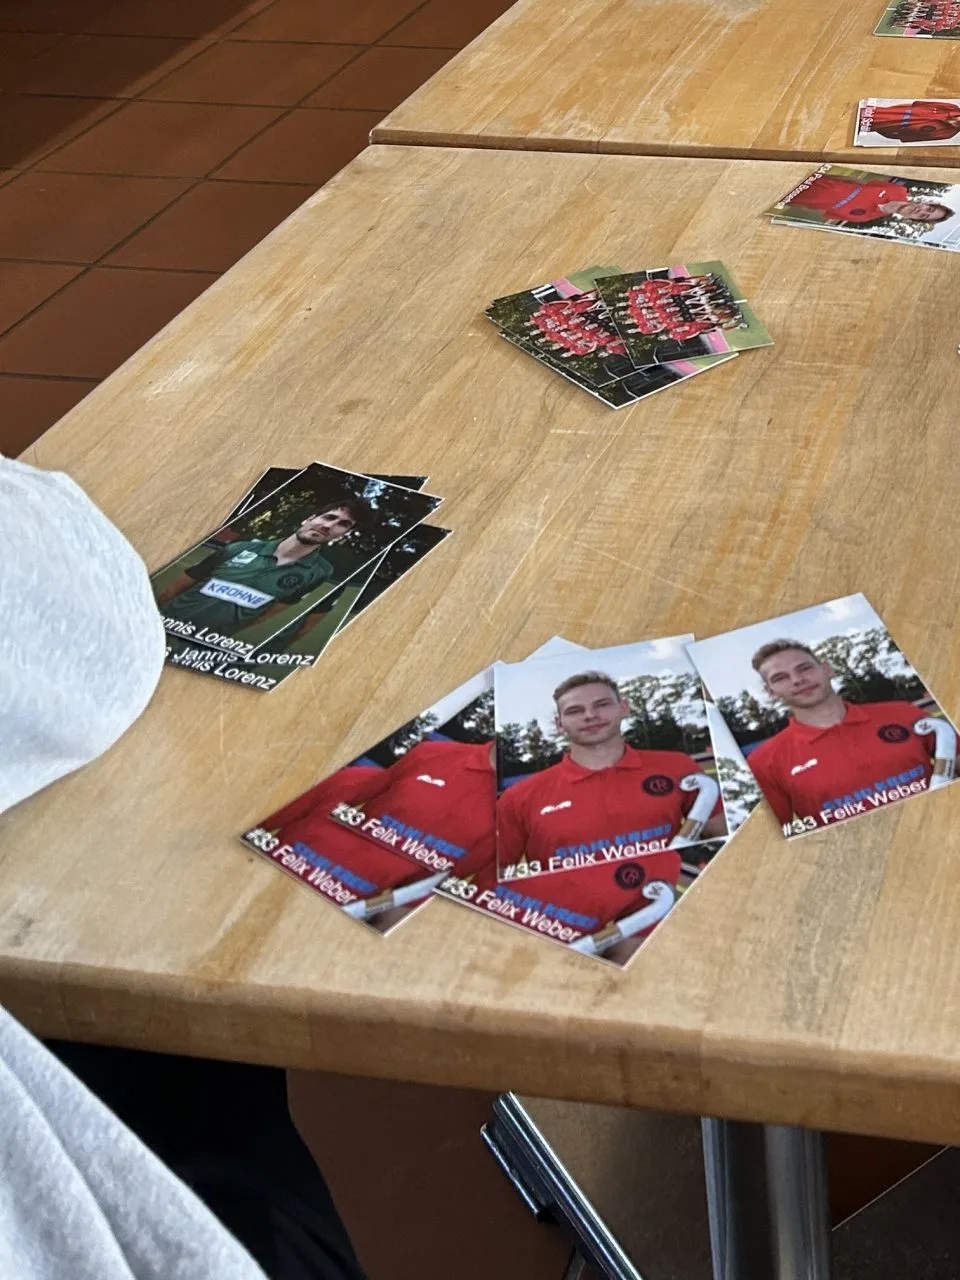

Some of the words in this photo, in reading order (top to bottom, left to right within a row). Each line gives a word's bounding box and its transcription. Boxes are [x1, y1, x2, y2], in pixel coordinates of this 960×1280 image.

[207, 582, 267, 605] KROHNE
[195, 627, 254, 655] Lorenz
[245, 651, 315, 666] Lorenz
[214, 663, 276, 690] Lorenz
[783, 816, 817, 837] #33
[820, 801, 866, 824] Felix
[866, 777, 927, 807] Weber
[331, 802, 365, 826] #33
[362, 818, 400, 847] Felix
[400, 837, 454, 871] Weber
[246, 827, 279, 852] #33
[272, 843, 311, 876] Felix
[307, 868, 358, 904] Weber
[503, 861, 541, 880] #33
[548, 851, 597, 872] Felix
[602, 838, 668, 862] Weber
[440, 877, 478, 900] #33
[476, 889, 520, 920] Felix
[521, 908, 583, 943] Weber
